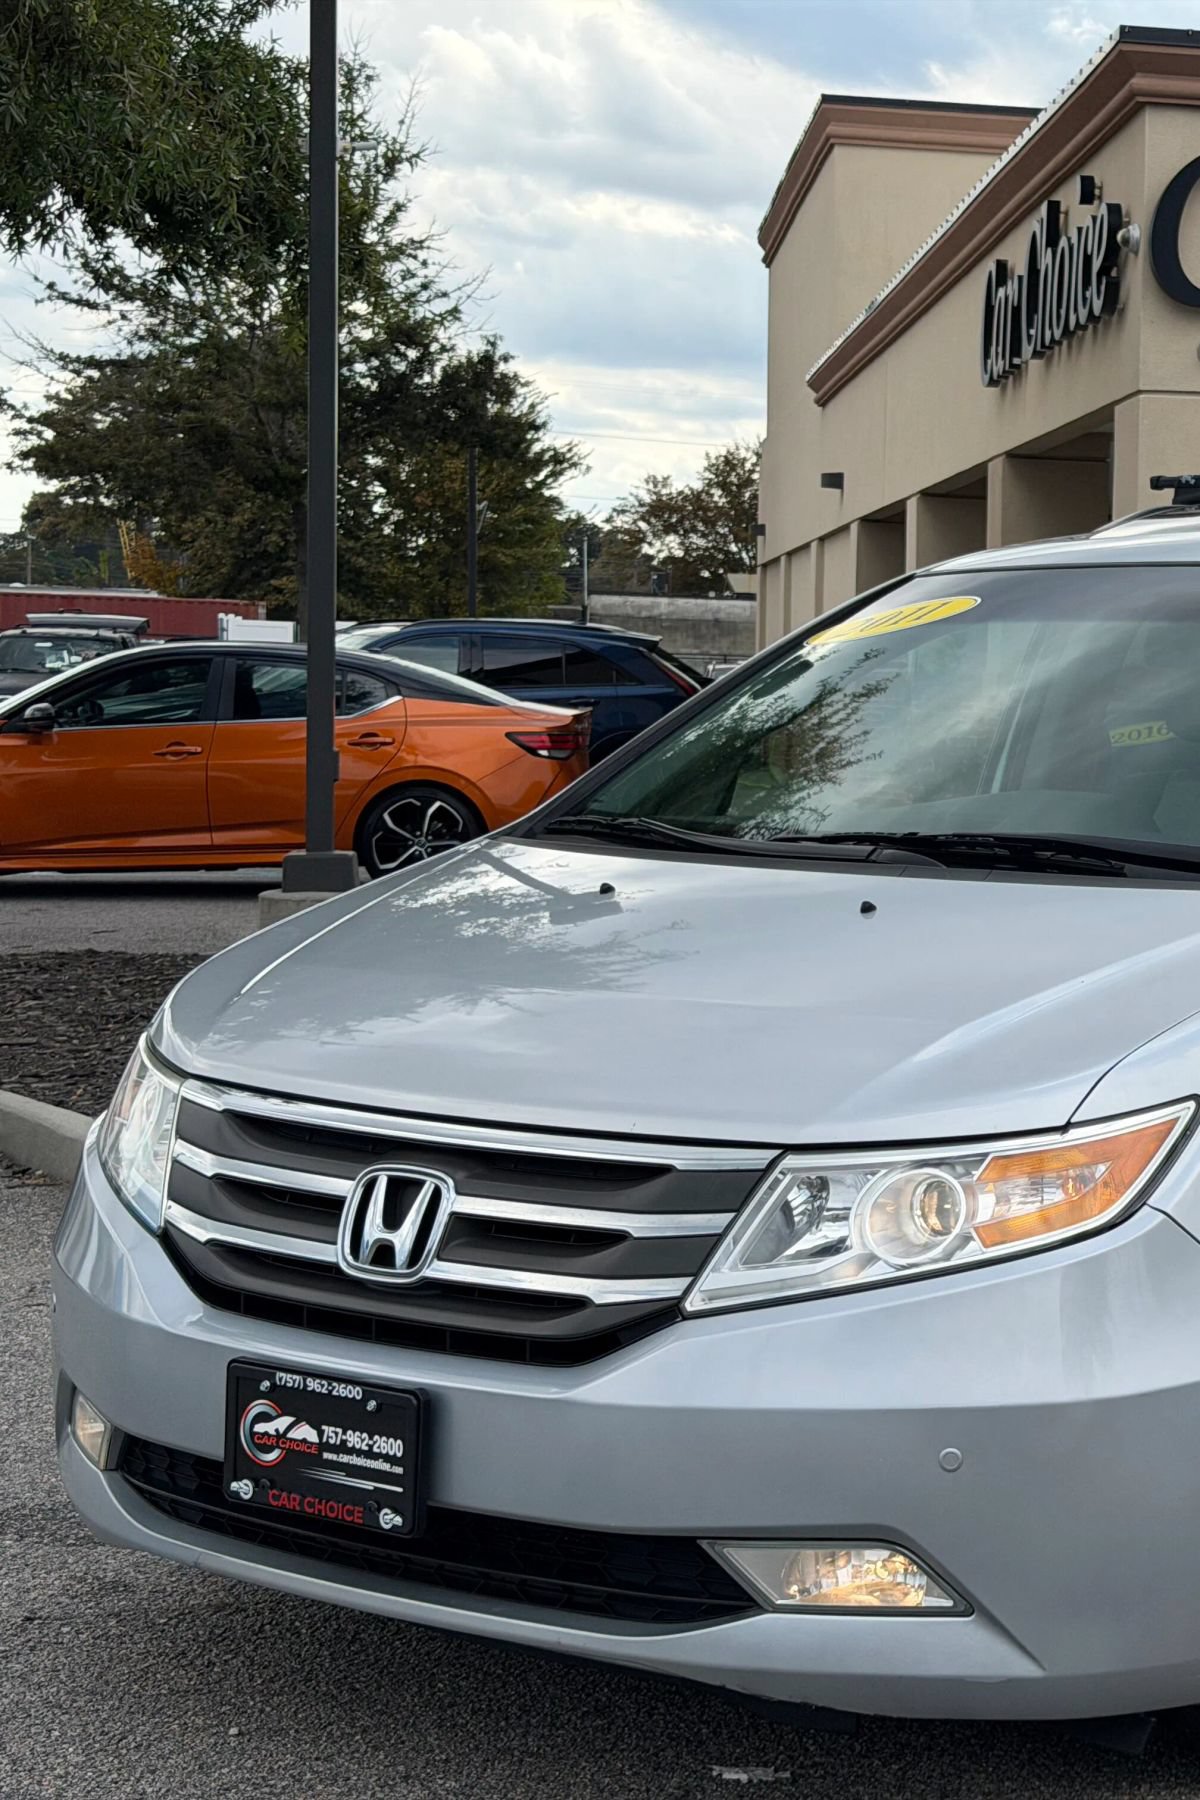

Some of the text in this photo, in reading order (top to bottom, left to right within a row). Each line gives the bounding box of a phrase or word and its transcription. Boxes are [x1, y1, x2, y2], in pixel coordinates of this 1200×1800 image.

[981, 174, 1124, 388] Car Choice
[275, 1371, 363, 1400] (757) 962-2600
[254, 1434, 319, 1454] CAR CHOICE
[321, 1425, 404, 1457] 757-962-2600
[322, 1451, 404, 1475] www.carchoiceonline.com
[268, 1489, 364, 1524] CAR CHOICE
